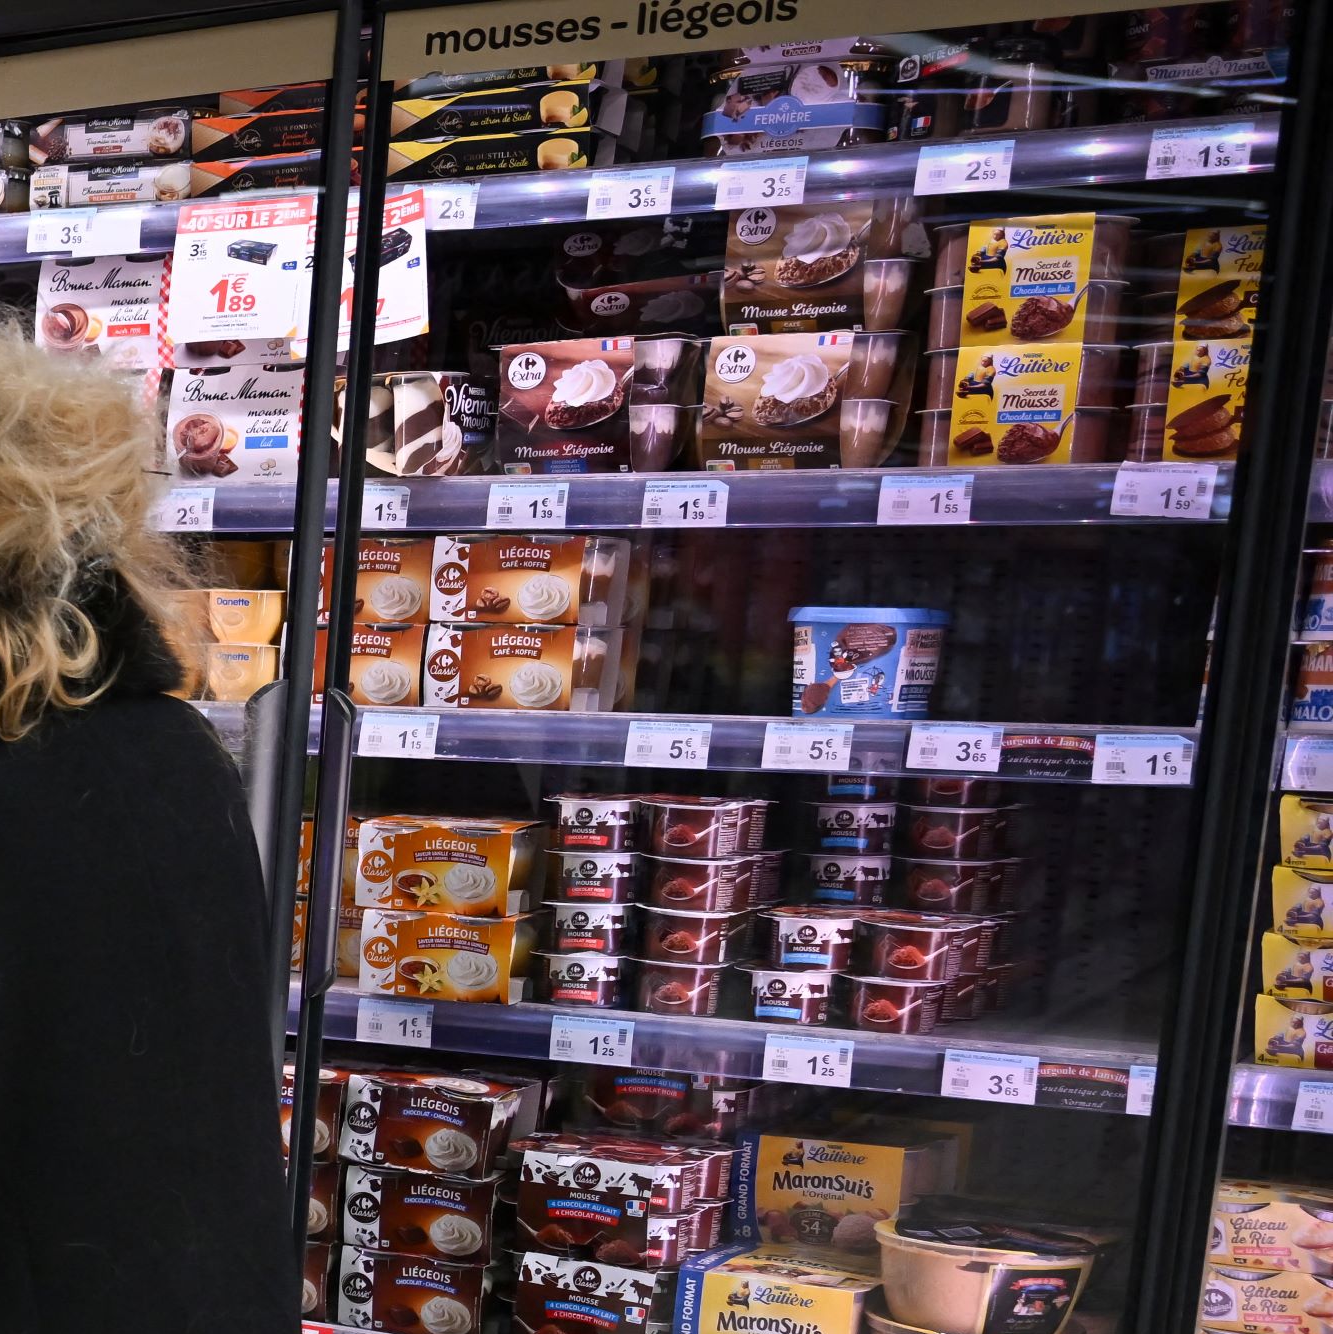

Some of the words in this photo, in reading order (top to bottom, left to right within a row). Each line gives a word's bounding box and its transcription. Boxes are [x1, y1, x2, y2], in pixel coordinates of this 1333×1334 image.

[425, 15, 601, 56] mousses
[637, 0, 798, 40] liégeois
[1149, 64, 1206, 81] Mamie
[1222, 58, 1266, 75] Nova
[754, 108, 811, 125] FERMIÈRE
[760, 137, 803, 149] LIÉGEOIS
[213, 213, 247, 229] SUR
[252, 211, 270, 227] LE
[739, 223, 773, 237] Extra
[49, 268, 94, 293] Bonne
[94, 266, 153, 291] Maman
[1015, 267, 1073, 284] Mousse
[741, 304, 787, 319] Mousse
[790, 301, 847, 319] Liégeoise
[718, 358, 754, 375] Extra
[511, 367, 545, 384] Extra
[183, 379, 228, 403] Bonne
[229, 376, 292, 400] Maman
[1002, 394, 1059, 410] Mousse
[247, 407, 288, 418] mousse
[245, 419, 288, 435] chocolat
[719, 442, 766, 456] Mousse
[768, 440, 824, 457] Liégeoise
[499, 545, 551, 562] LIÉGEOIS
[501, 559, 520, 569] CAFÉ
[524, 559, 548, 571] KOFFIE
[437, 576, 466, 590] Classic
[491, 633, 542, 649] LIÉGEOIS
[493, 647, 511, 657] CAFÉ
[515, 647, 538, 658] KOFFIE
[429, 664, 458, 678] Classic
[425, 837, 477, 853] LIÉGEOIS
[742, 1140, 753, 1179] FORMAT
[807, 1147, 869, 1166] Laitière
[772, 1171, 873, 1200] MaronSui's
[570, 1192, 600, 1201] MOUSSE
[737, 1180, 749, 1220] GRAND
[802, 1190, 844, 1201] L'Original
[558, 1201, 590, 1212] CHOCOLAT
[604, 1206, 617, 1215] LAIT
[1230, 1217, 1288, 1233] Gâteau
[1250, 1232, 1276, 1250] Riz
[685, 1278, 697, 1317] FORMAT
[753, 1289, 816, 1308] Laitière
[1241, 1285, 1299, 1301] Gâteau
[1261, 1300, 1288, 1317] Riz
